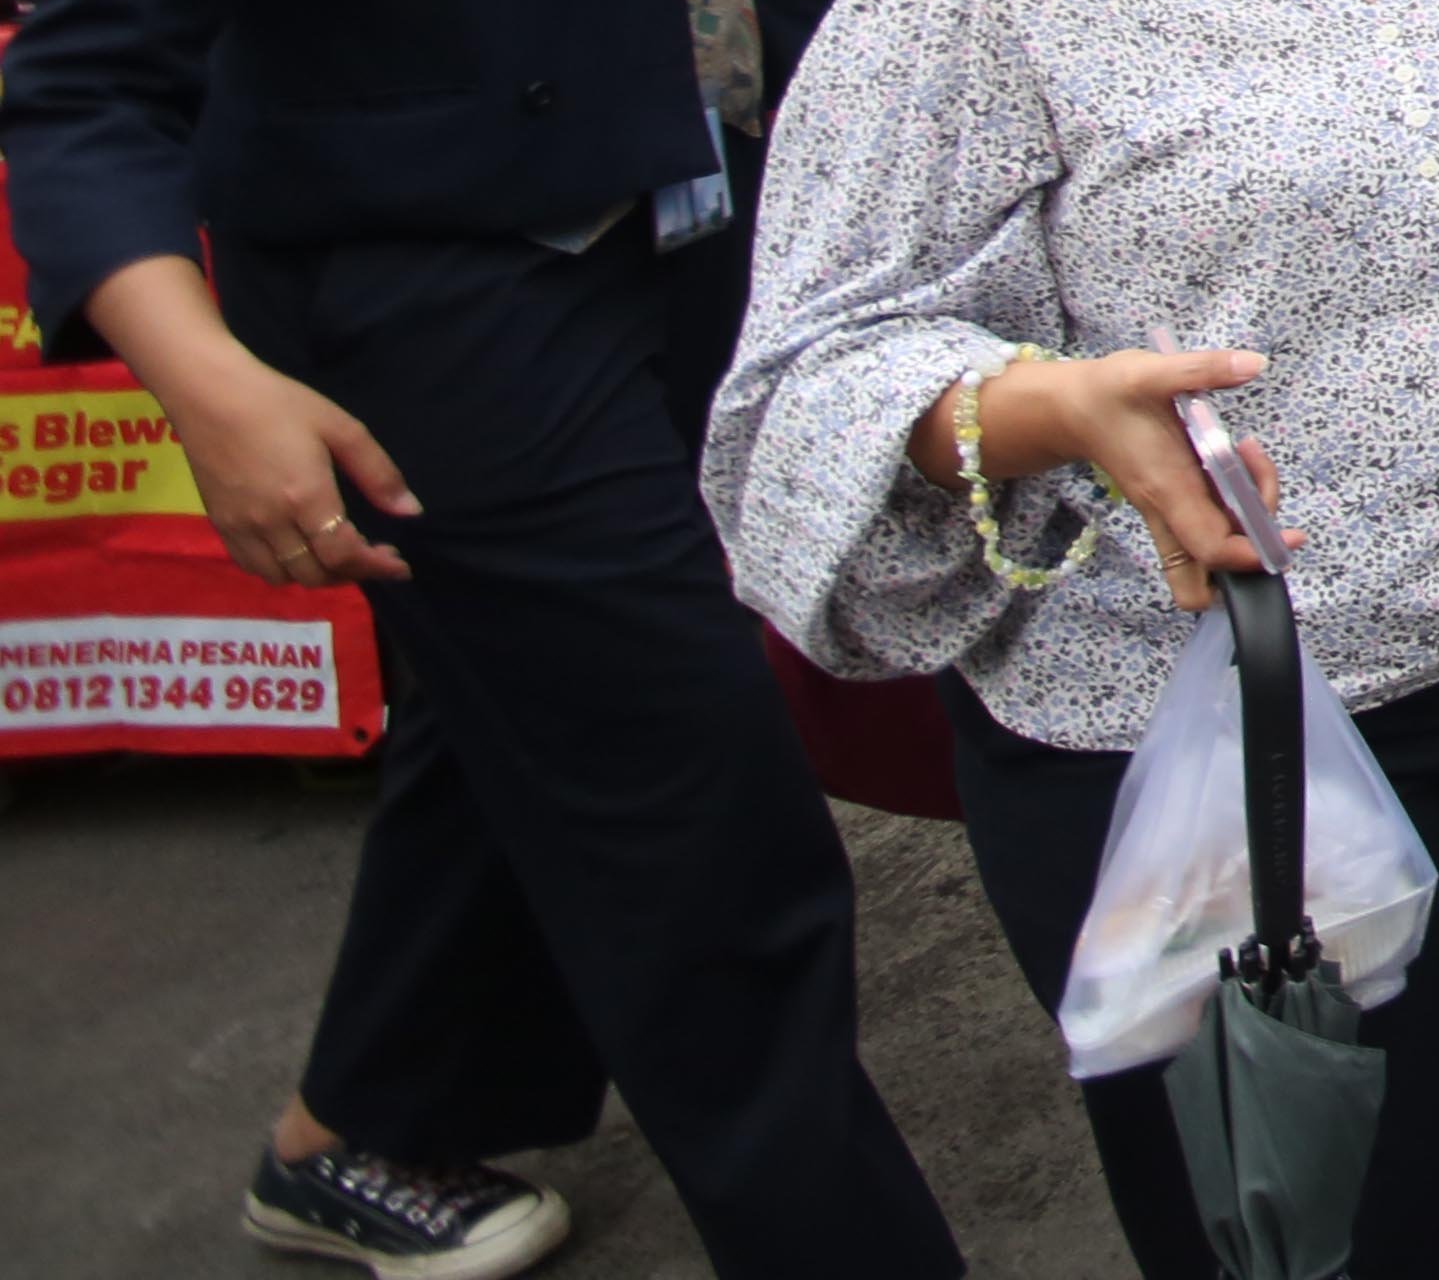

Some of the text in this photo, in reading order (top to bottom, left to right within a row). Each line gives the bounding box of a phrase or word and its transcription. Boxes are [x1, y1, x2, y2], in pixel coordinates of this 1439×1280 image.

[0, 455, 148, 503] egar
[180, 642, 323, 670] PESANAN
[4, 677, 325, 713] 0812 1344 9629
